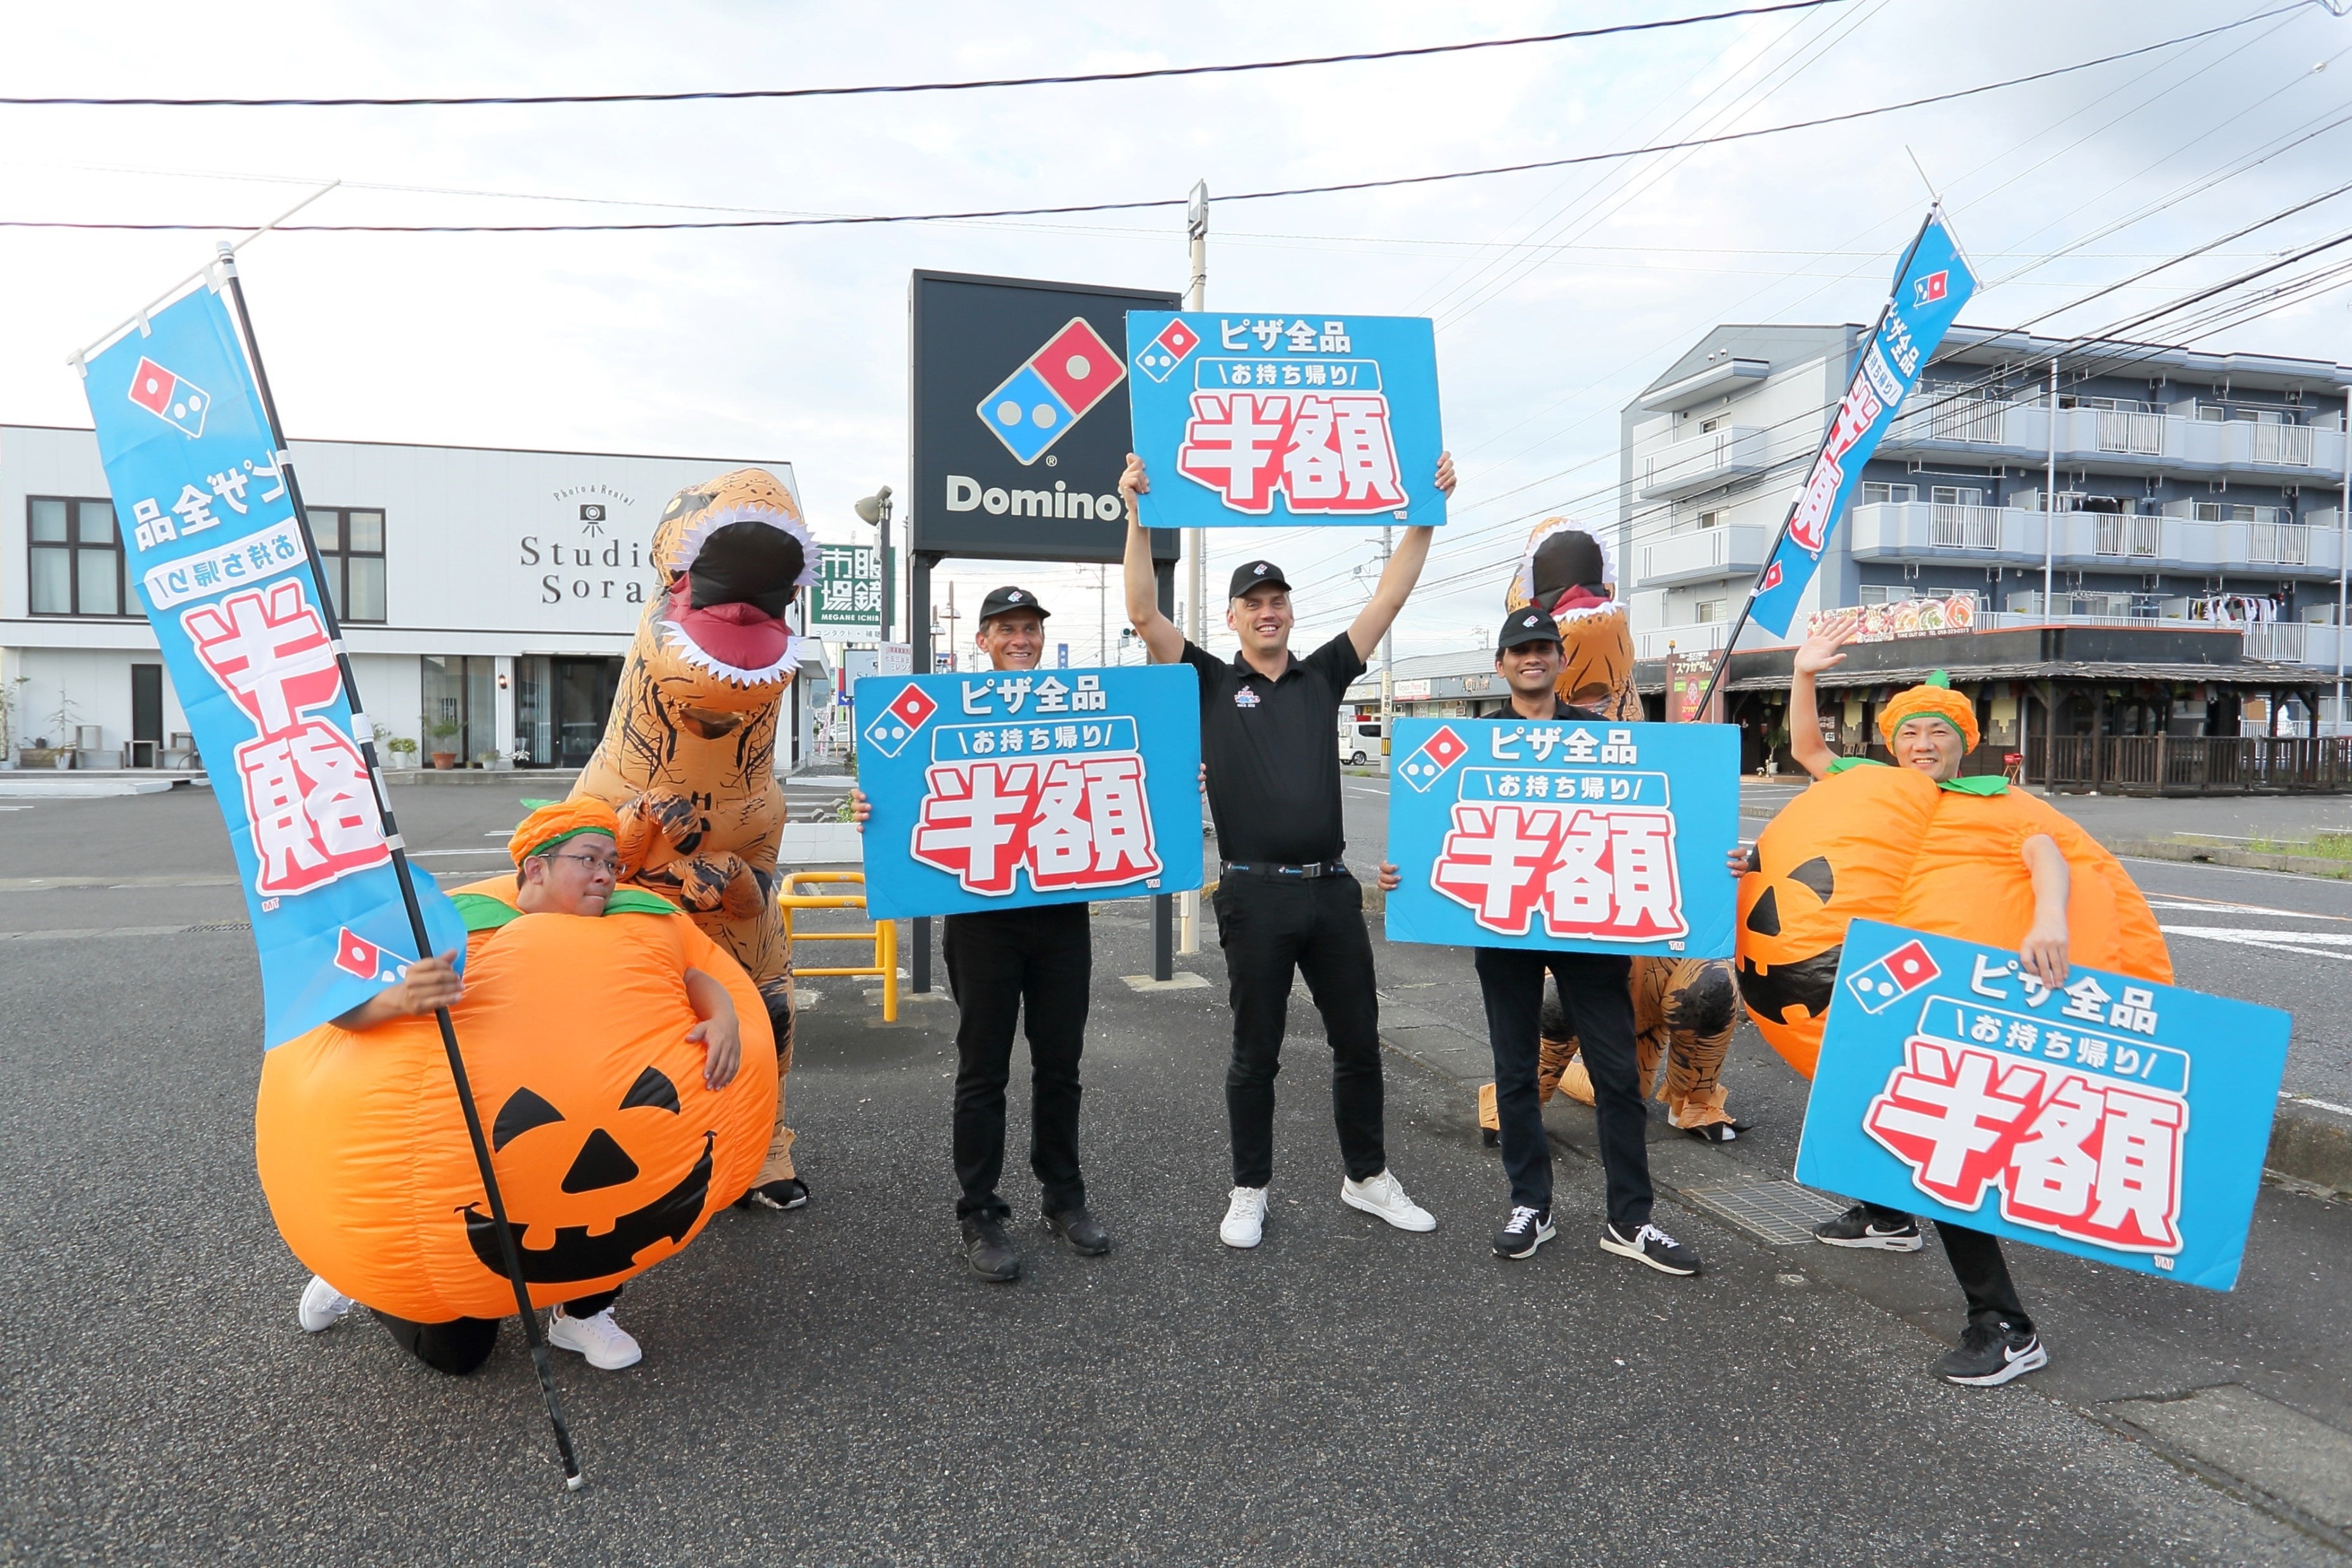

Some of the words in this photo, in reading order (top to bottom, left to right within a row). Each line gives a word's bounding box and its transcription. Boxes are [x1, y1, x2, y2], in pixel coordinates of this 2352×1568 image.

[1220, 318, 1351, 354] ピザ全品
[1181, 393, 1406, 510] 半額
[553, 485, 586, 502] Photo
[591, 485, 596, 493] &
[601, 484, 636, 506] Rental
[542, 574, 646, 604] Sora
[962, 675, 1106, 715] ピザ全品
[1492, 727, 1637, 765] ピザ全品
[914, 757, 1160, 893] 半額
[1146, 879, 1161, 888] TM
[1435, 806, 1686, 939] 半額
[1668, 941, 1685, 951] TM
[1866, 1041, 2183, 1252] 半額
